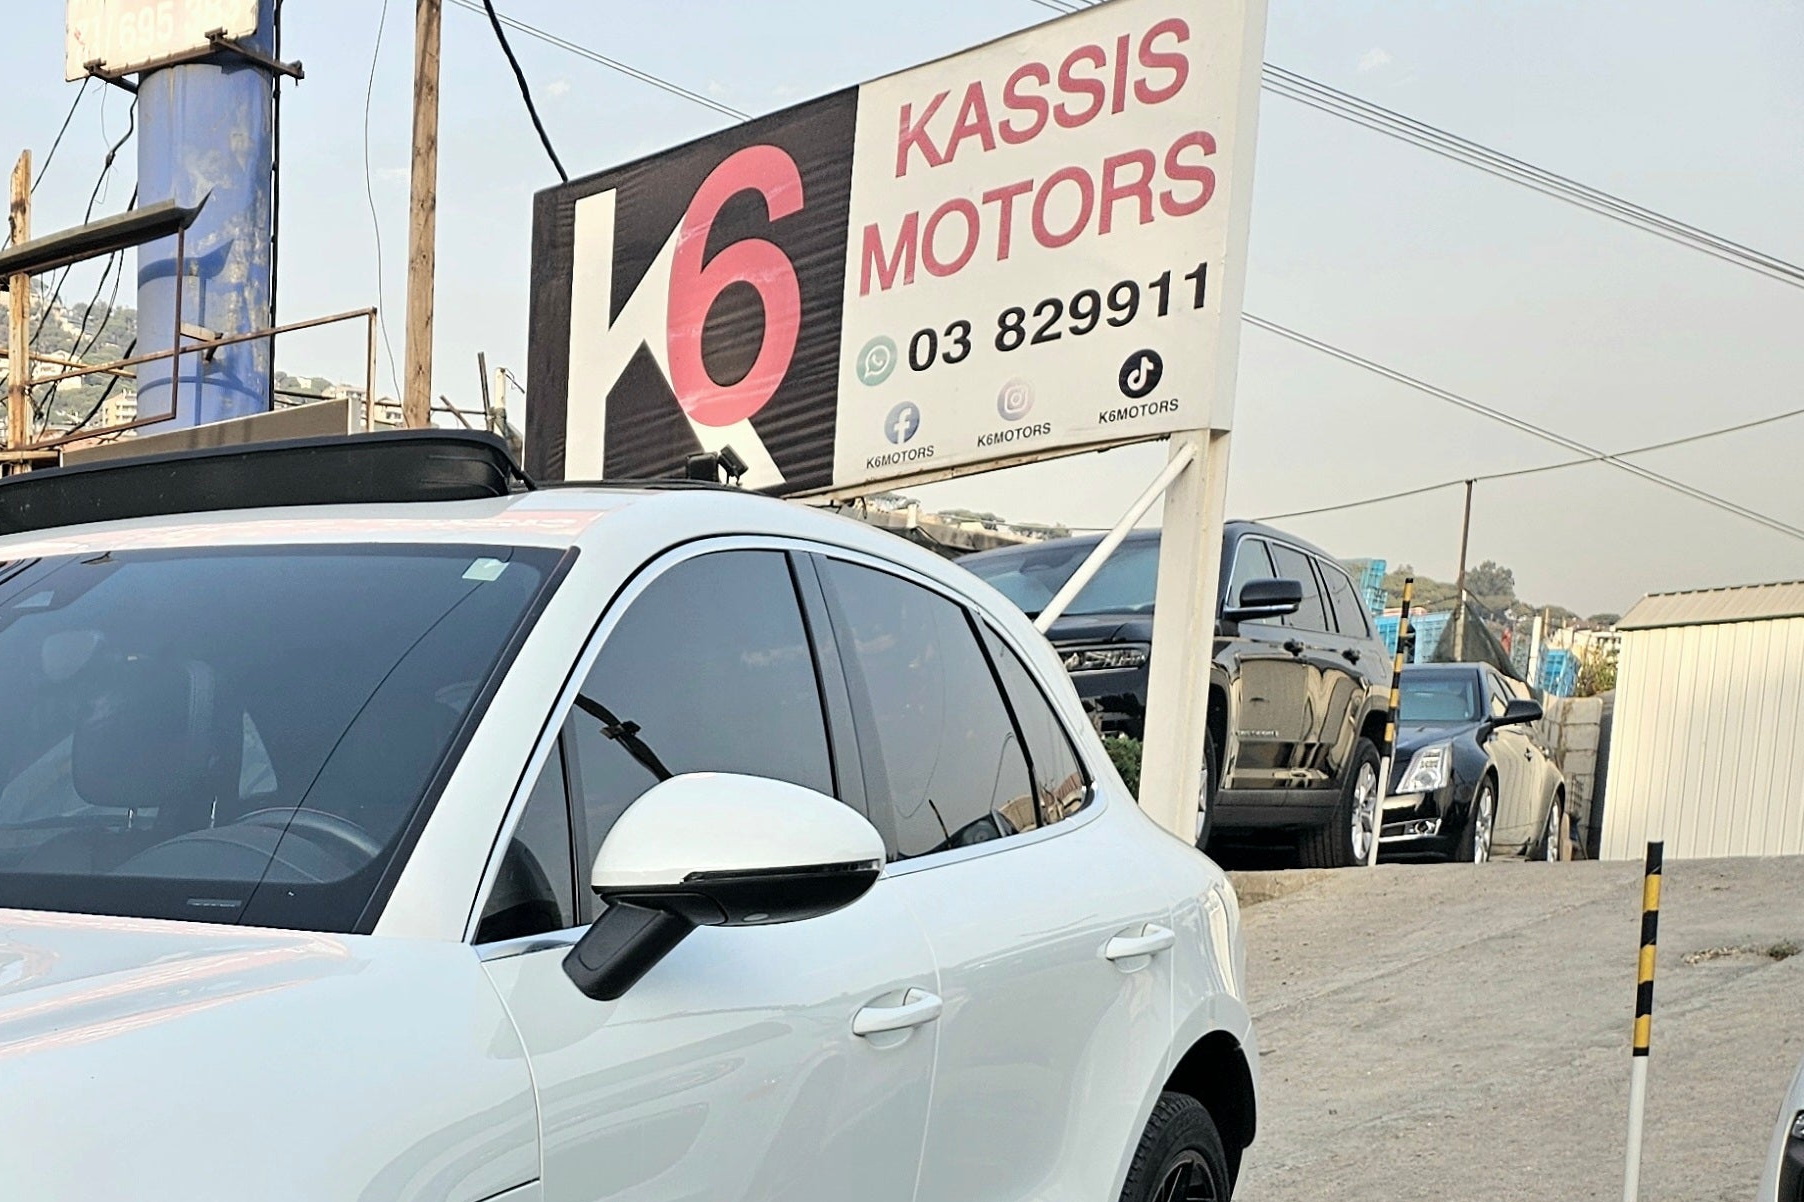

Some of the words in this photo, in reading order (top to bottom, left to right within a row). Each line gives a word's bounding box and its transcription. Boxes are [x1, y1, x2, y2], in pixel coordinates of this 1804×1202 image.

[895, 17, 1191, 178] KASSIS
[859, 130, 1217, 298] MOTORS
[565, 144, 805, 485] K6
[908, 319, 972, 372] 03
[995, 261, 1209, 352] 829911
[865, 445, 935, 470] K6MOTORS
[976, 422, 1052, 448] K6MOTORS
[1098, 398, 1180, 425] K6MOTORS
